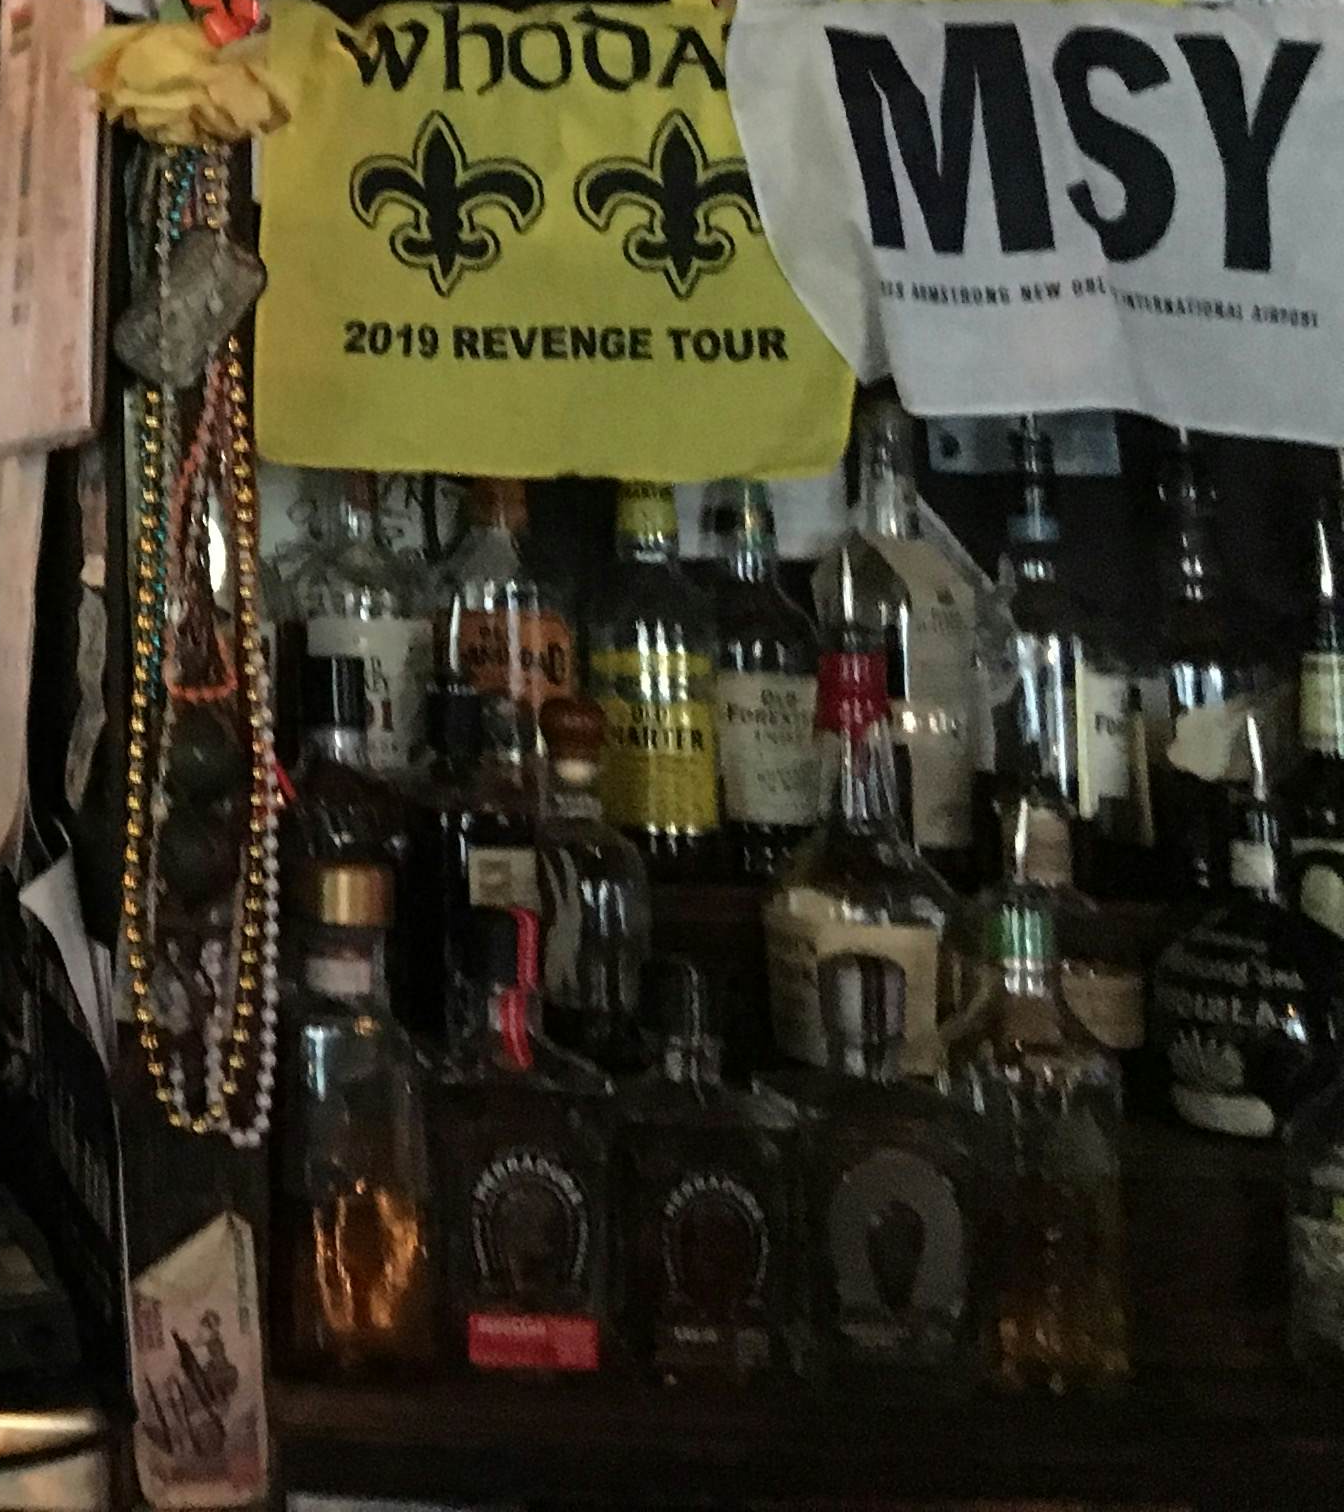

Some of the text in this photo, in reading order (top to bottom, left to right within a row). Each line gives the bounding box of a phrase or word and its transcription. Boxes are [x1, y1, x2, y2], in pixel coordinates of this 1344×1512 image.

[334, 2, 730, 96] WHODA
[823, 22, 1325, 271] MSY
[911, 281, 1012, 306] ARMSTRONG
[1019, 281, 1062, 303] NEW
[1118, 289, 1244, 322] INTERNATIONAL
[1250, 303, 1320, 329] AIRPORT
[343, 321, 789, 363] 2019 REVENGE TOUR
